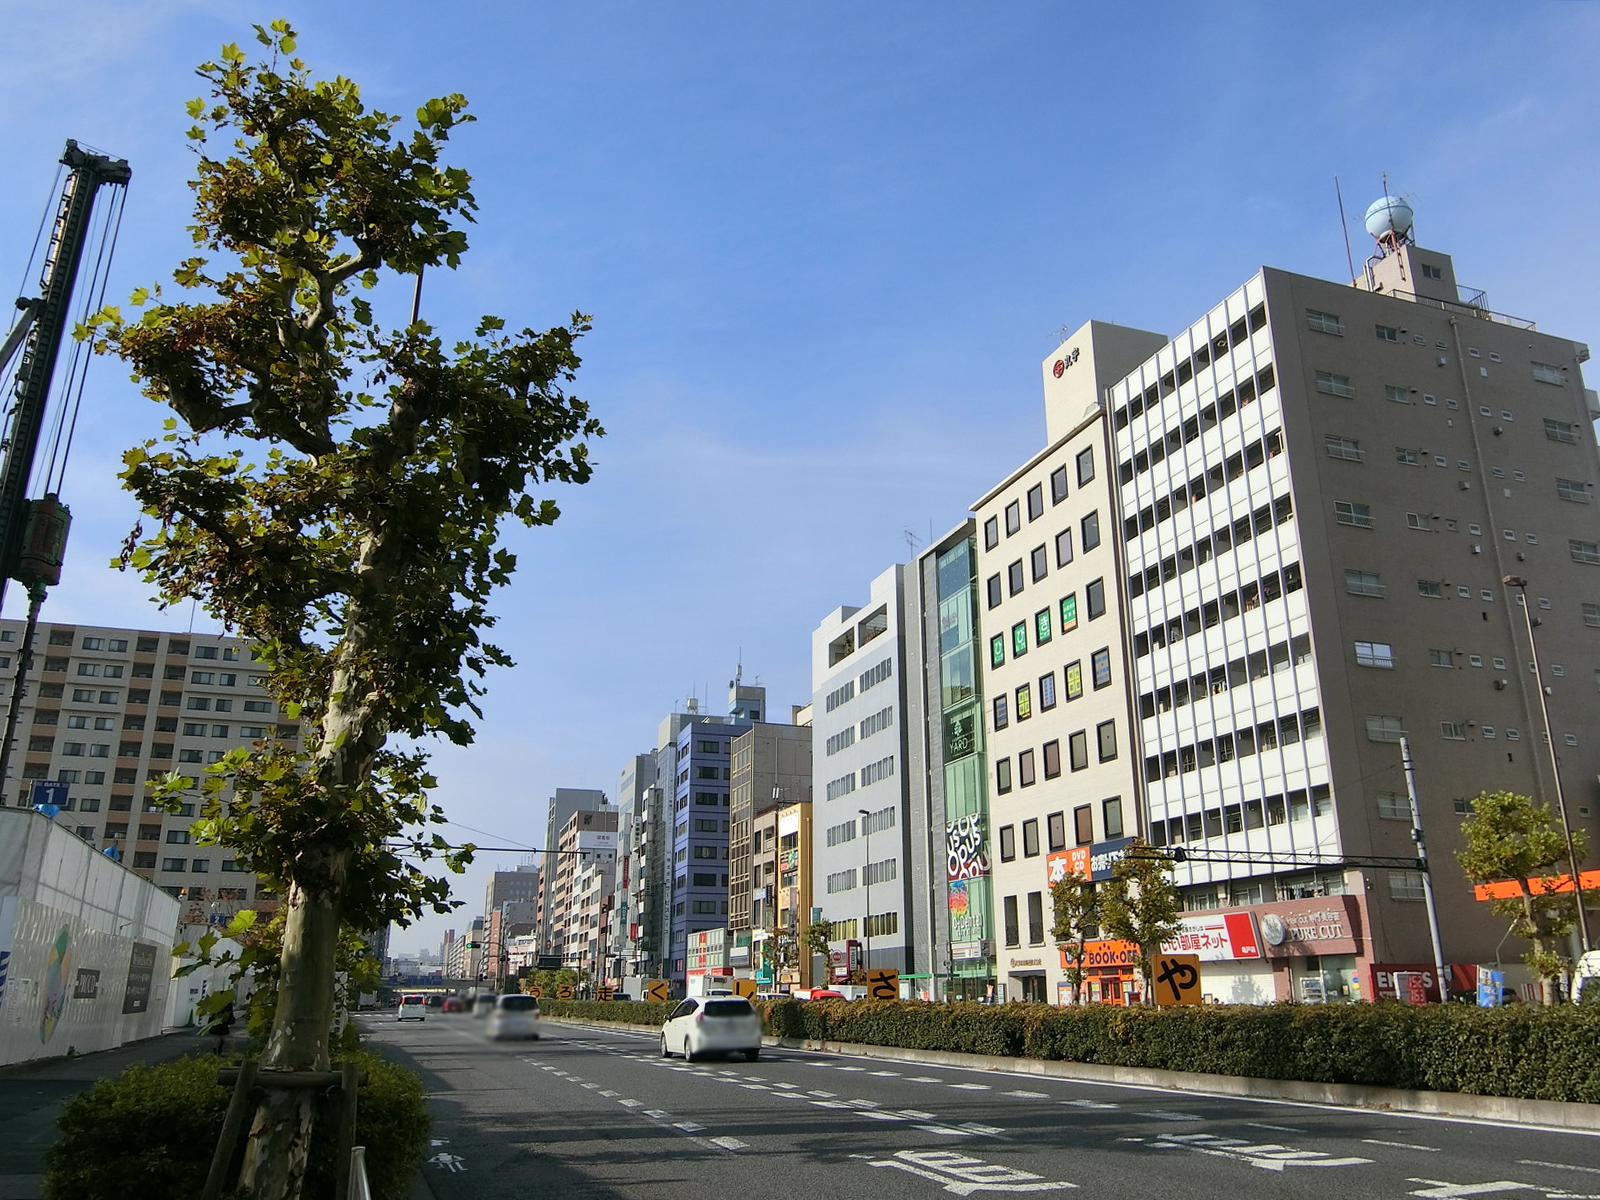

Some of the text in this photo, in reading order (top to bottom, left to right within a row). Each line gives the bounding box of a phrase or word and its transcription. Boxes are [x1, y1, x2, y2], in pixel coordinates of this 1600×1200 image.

[1040, 615, 1050, 631] き
[949, 737, 968, 754] YARD
[46, 788, 54, 803] 1
[1072, 850, 1086, 862] DVD
[1048, 855, 1067, 883] 本
[1074, 861, 1085, 871] CD
[1289, 924, 1343, 941] PURE CUT
[1161, 932, 1229, 952] いい部屋ネット
[870, 971, 897, 999] さ
[1157, 958, 1198, 1001] や
[1377, 972, 1433, 988] ENS
[531, 986, 541, 999] う
[559, 986, 572, 998] ろ
[597, 987, 613, 1001] 走
[651, 983, 665, 999] く
